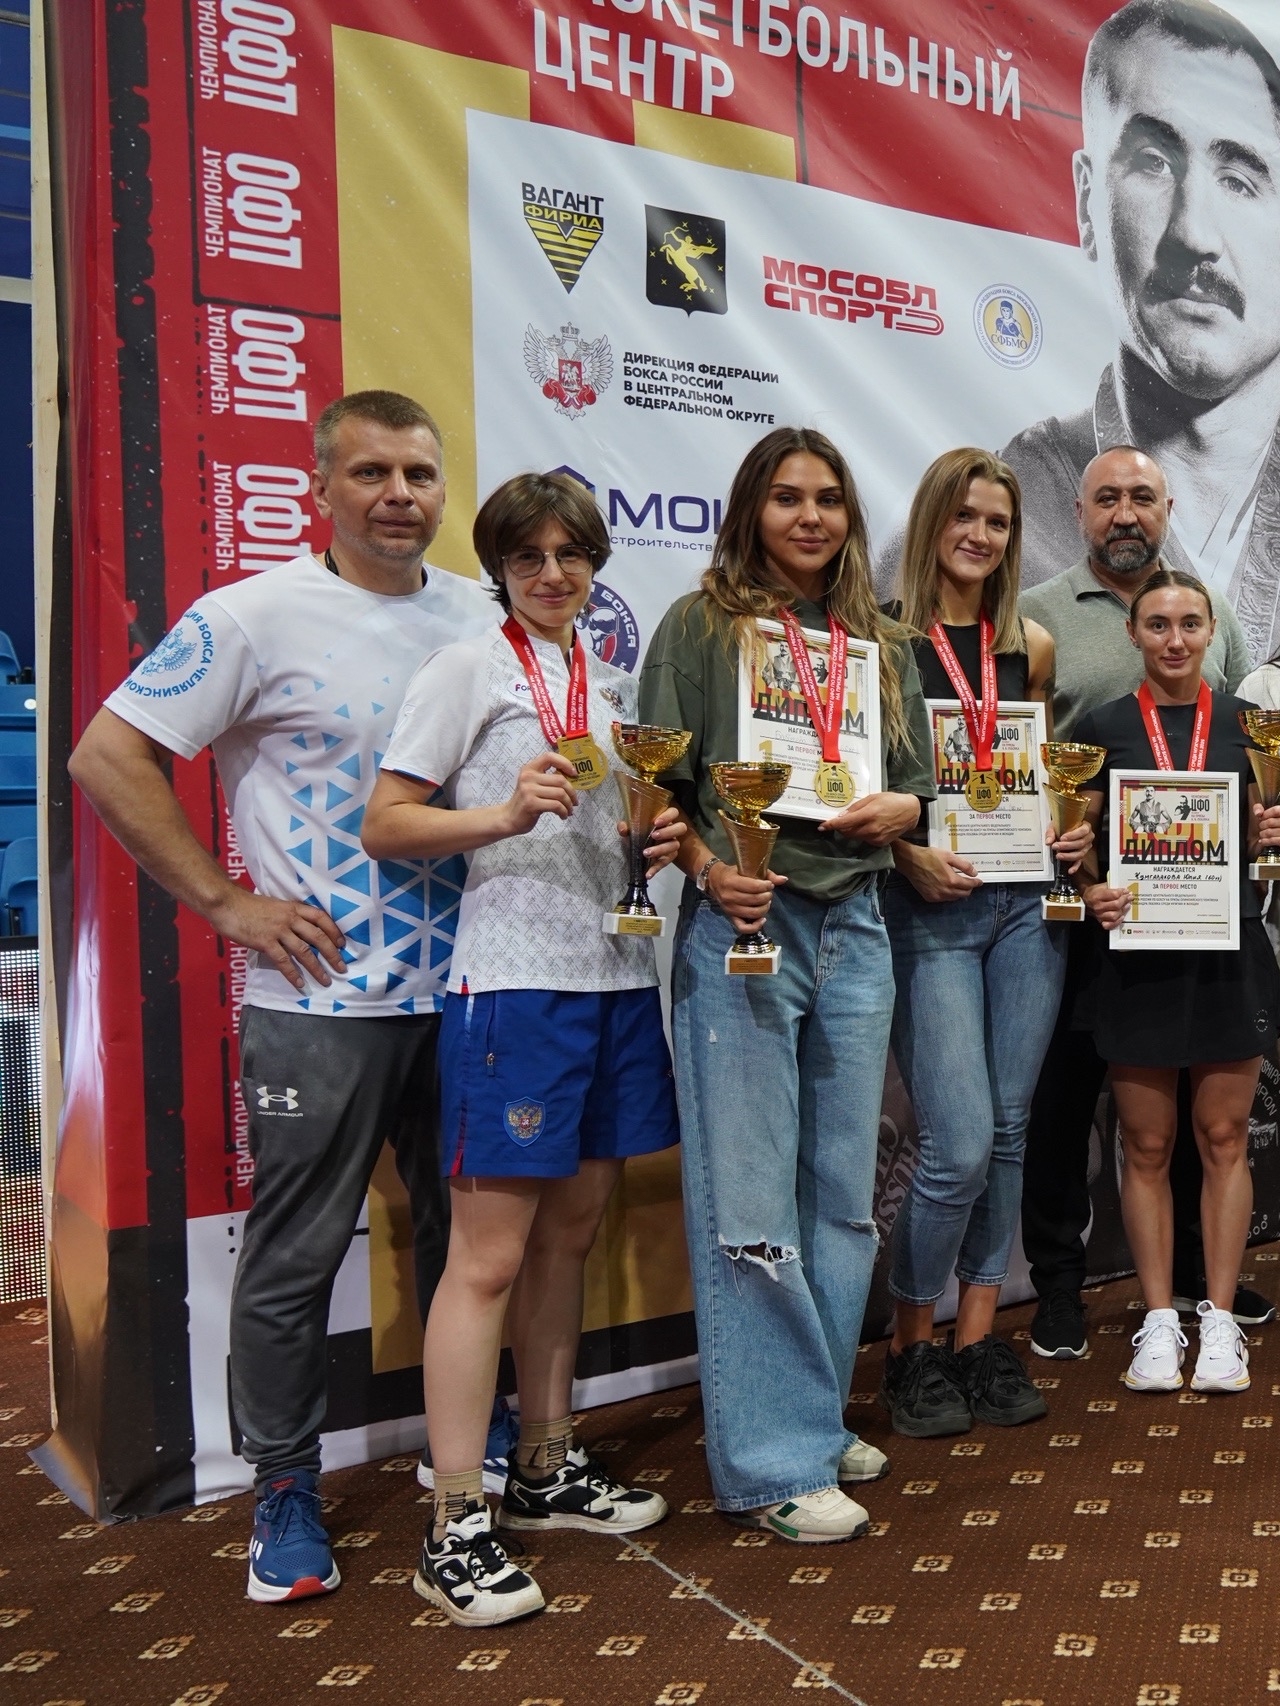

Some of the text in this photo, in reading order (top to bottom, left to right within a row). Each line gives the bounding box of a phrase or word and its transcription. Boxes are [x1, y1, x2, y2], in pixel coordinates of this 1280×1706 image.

[199, 0, 217, 100] ЧЕМПИОНА
[221, 0, 298, 116] ЦФО
[534, 9, 734, 116] ЦЕНТР
[203, 146, 223, 257] ЧЕМПИОНАТ
[226, 152, 302, 269] ЦФО
[522, 182, 604, 216] ВАГАНТ
[762, 255, 937, 311] МОСОБЛ
[764, 284, 900, 333] СПОРТ
[208, 304, 227, 414] ЧЕМПИОНАТ
[230, 307, 307, 421] ЦФО
[991, 334, 1028, 349] СФБМО
[623, 351, 779, 384] ДИРЕКЦИЯ ФЕДЕРАЦИИ
[623, 366, 723, 391] БОКСА РОССИИ
[623, 395, 775, 425] ФЕДЕРАЛЬНОМ ОКРУГЕ
[624, 380, 733, 406] В ЦЕНТРАЛЬНОМ
[213, 461, 235, 570] ЧЕМПИОНАТ
[236, 464, 311, 571] ЦФО
[610, 535, 714, 552] строительств
[601, 591, 637, 648] БОКСА
[124, 623, 214, 698] БОКСА ЧЕЛЯБИНСКОЙ
[801, 657, 811, 676] СРЕДИ
[1001, 728, 1019, 740] ЦФО
[827, 781, 844, 793] ЦФО
[1191, 799, 1210, 812] ЦФО
[1122, 838, 1225, 864] ДИПЛОМ
